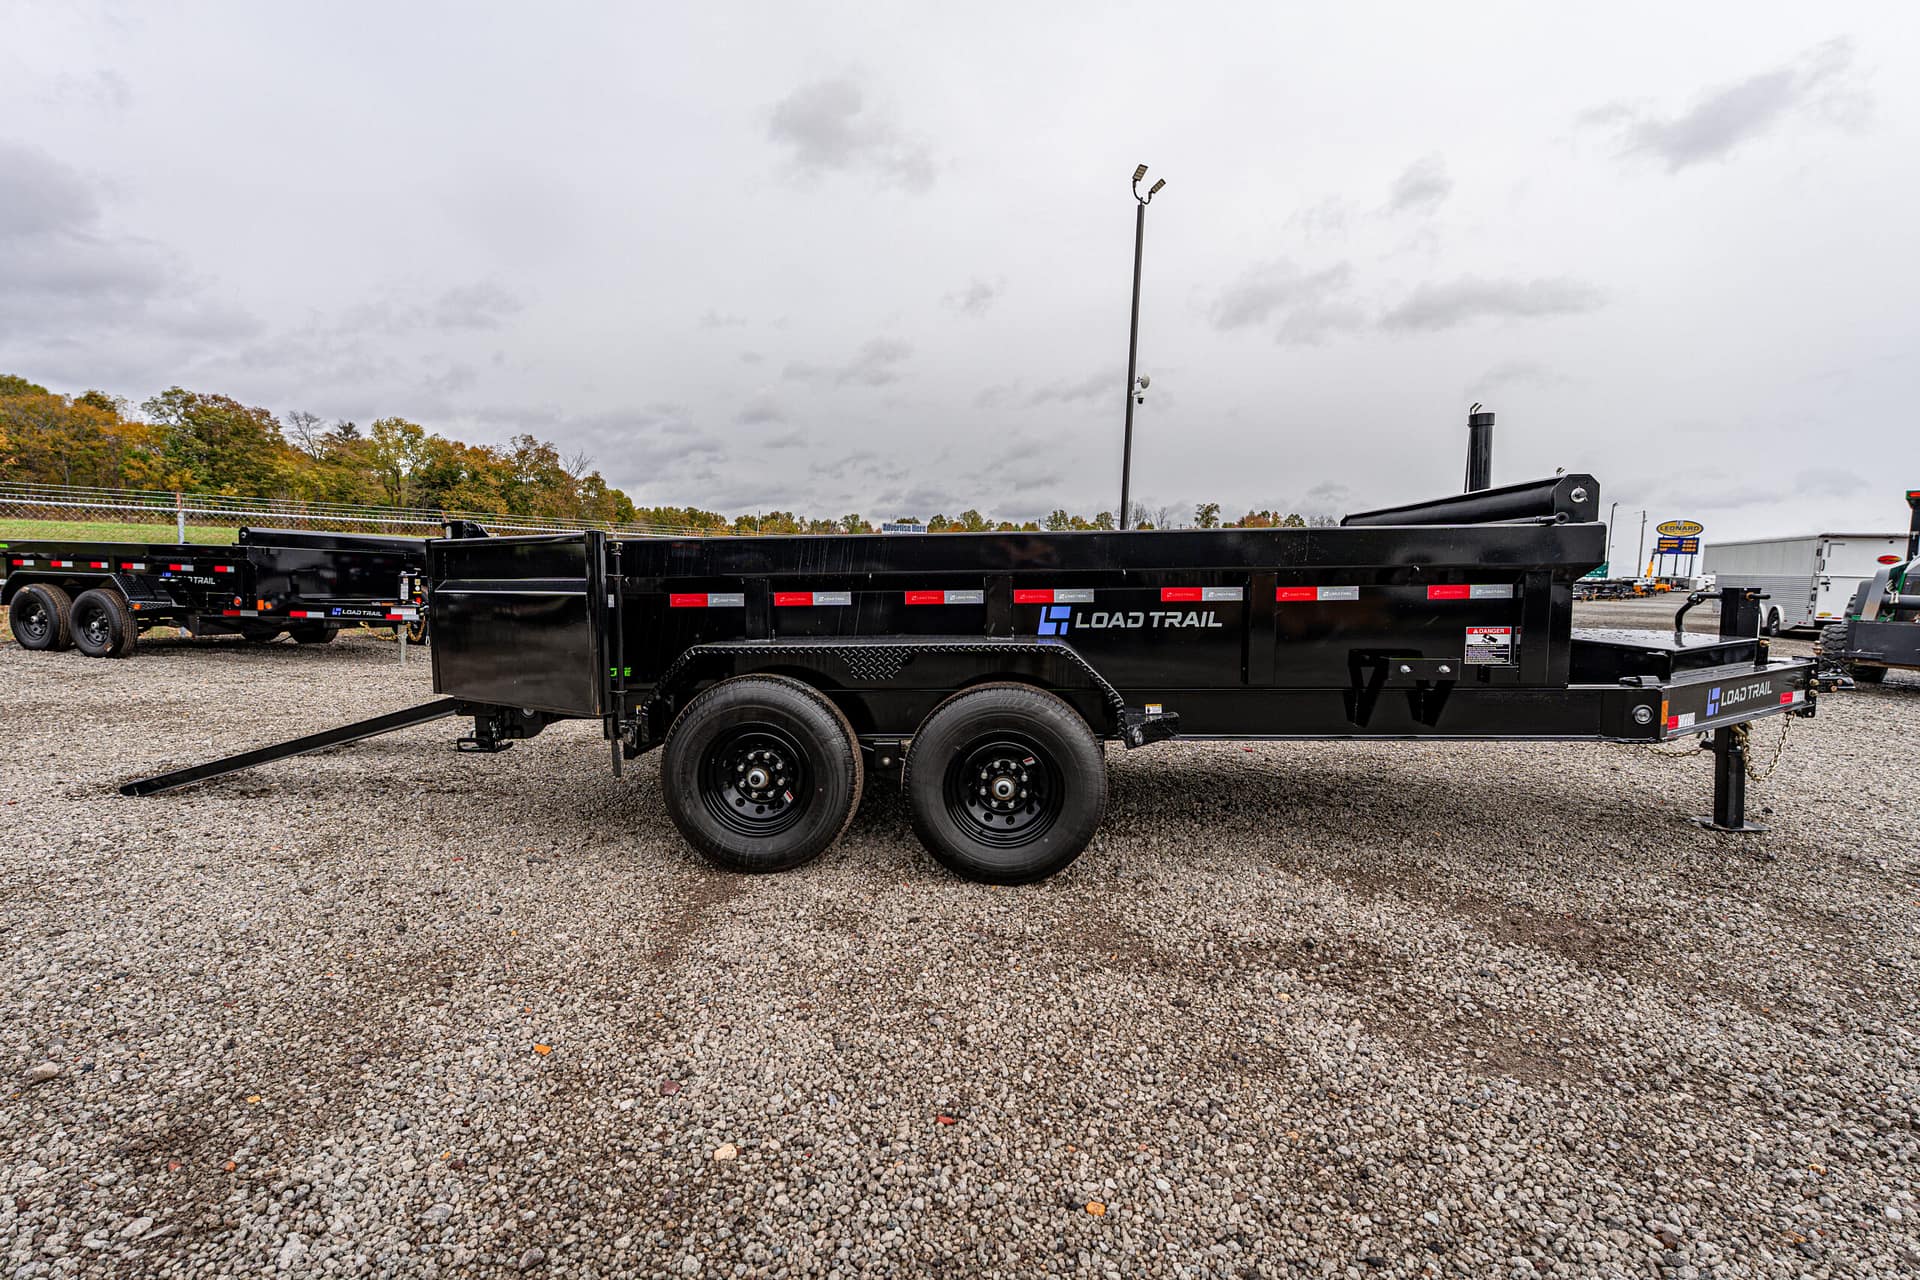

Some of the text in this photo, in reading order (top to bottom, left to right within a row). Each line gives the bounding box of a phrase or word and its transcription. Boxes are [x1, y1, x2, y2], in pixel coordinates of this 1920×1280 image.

[193, 576, 216, 585] TRAIL
[342, 608, 361, 616] LOAD
[1075, 611, 1223, 628] LOAD TRAIL
[1721, 680, 1772, 706] LOAD TRAIL
